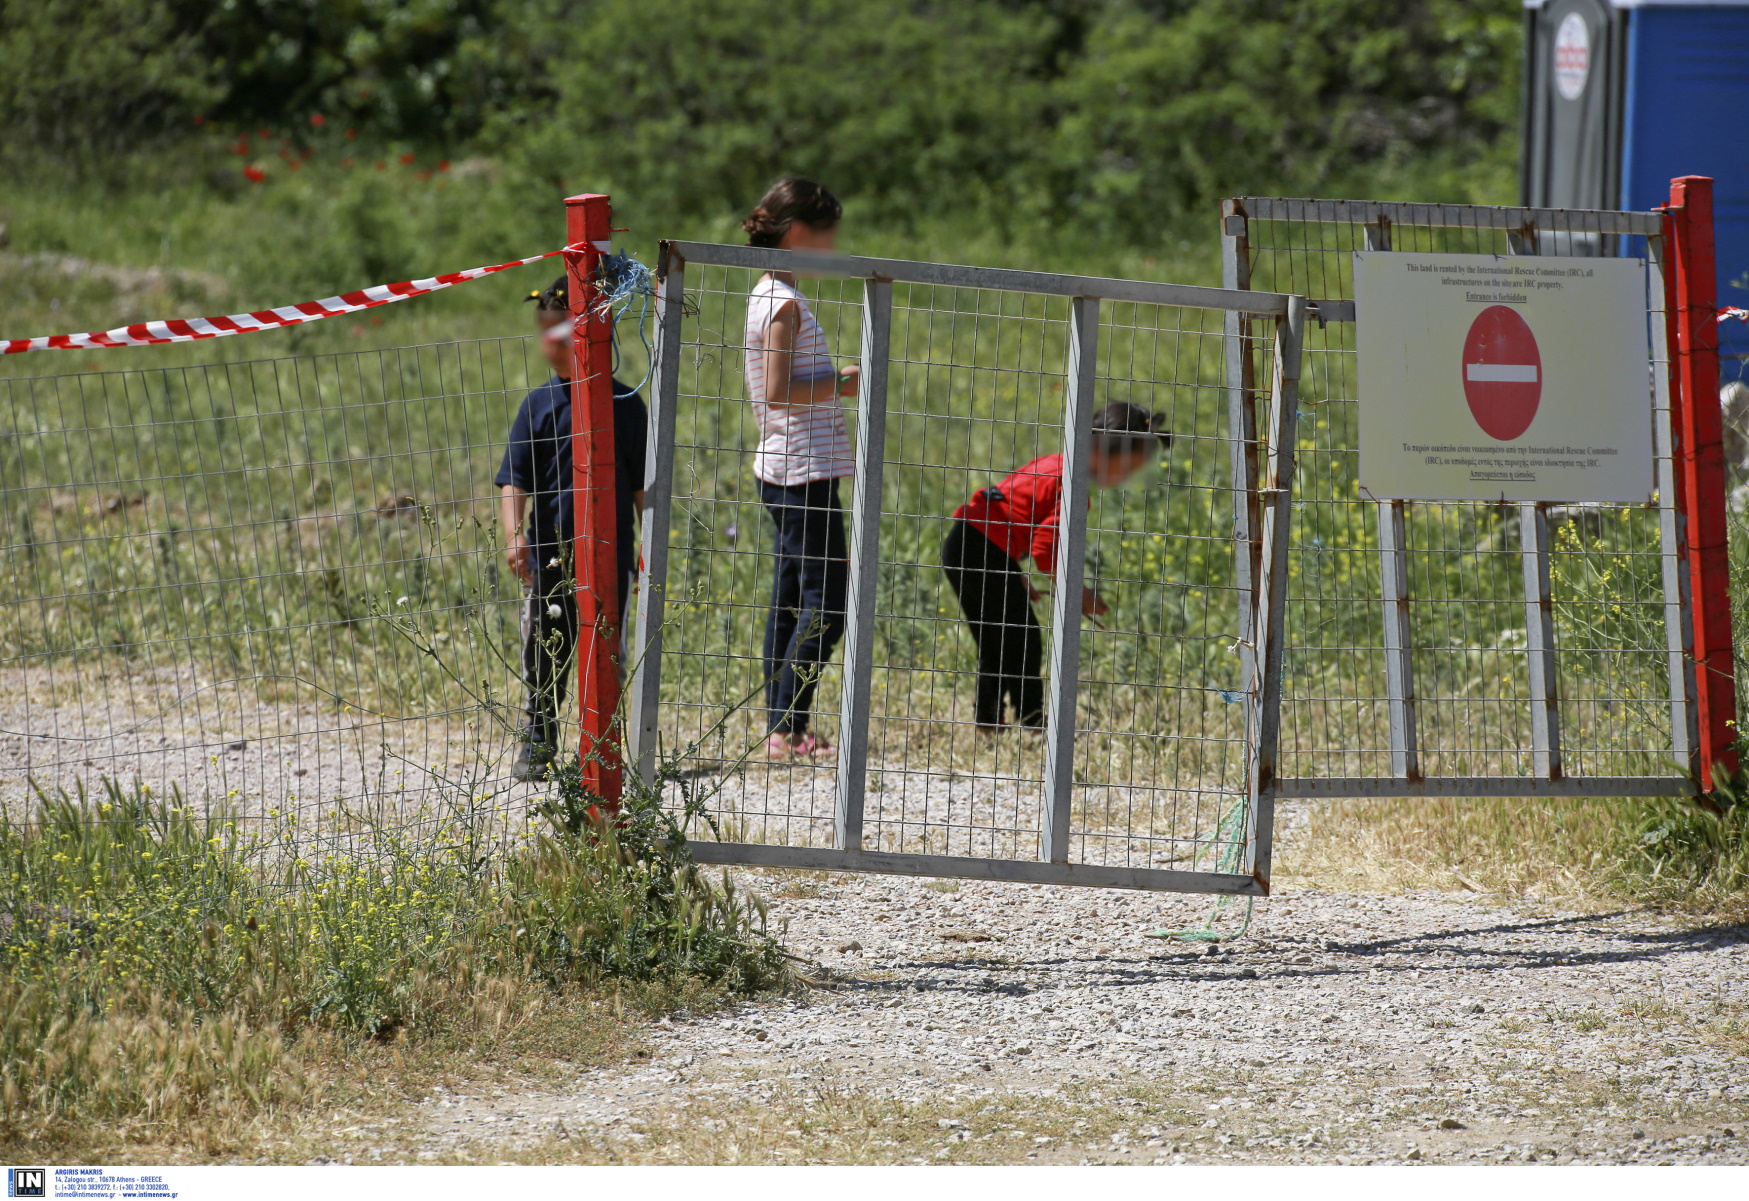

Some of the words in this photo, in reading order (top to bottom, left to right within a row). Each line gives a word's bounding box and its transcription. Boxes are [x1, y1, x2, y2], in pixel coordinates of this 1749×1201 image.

[1459, 265, 1464, 275] by
[1477, 266, 1513, 274] International
[1515, 267, 1534, 275] Rescue
[1536, 268, 1566, 276] Committee
[1567, 268, 1585, 277] (IRC),
[1441, 277, 1482, 285] infrastructures
[1492, 278, 1500, 286] the
[1538, 281, 1563, 290] property.
[1466, 292, 1491, 300] Entrance
[1499, 293, 1527, 301] forbidden
[1402, 443, 1410, 452] Το
[1412, 444, 1430, 453] παρόν
[1431, 444, 1456, 452] οικόπεδο
[1518, 447, 1527, 455] την
[1529, 446, 1564, 454] International
[1587, 447, 1618, 455] Committee
[1425, 456, 1443, 465] (IRC),
[1451, 457, 1477, 467] υποδομές
[1478, 457, 1492, 467] εντός
[1505, 458, 1528, 468] περιοχής
[1544, 458, 1574, 468] ιδιοκτησία
[1576, 461, 1586, 469] της
[1470, 470, 1508, 479] Απαγορεύεται
[1514, 470, 1535, 479] είσοδος
